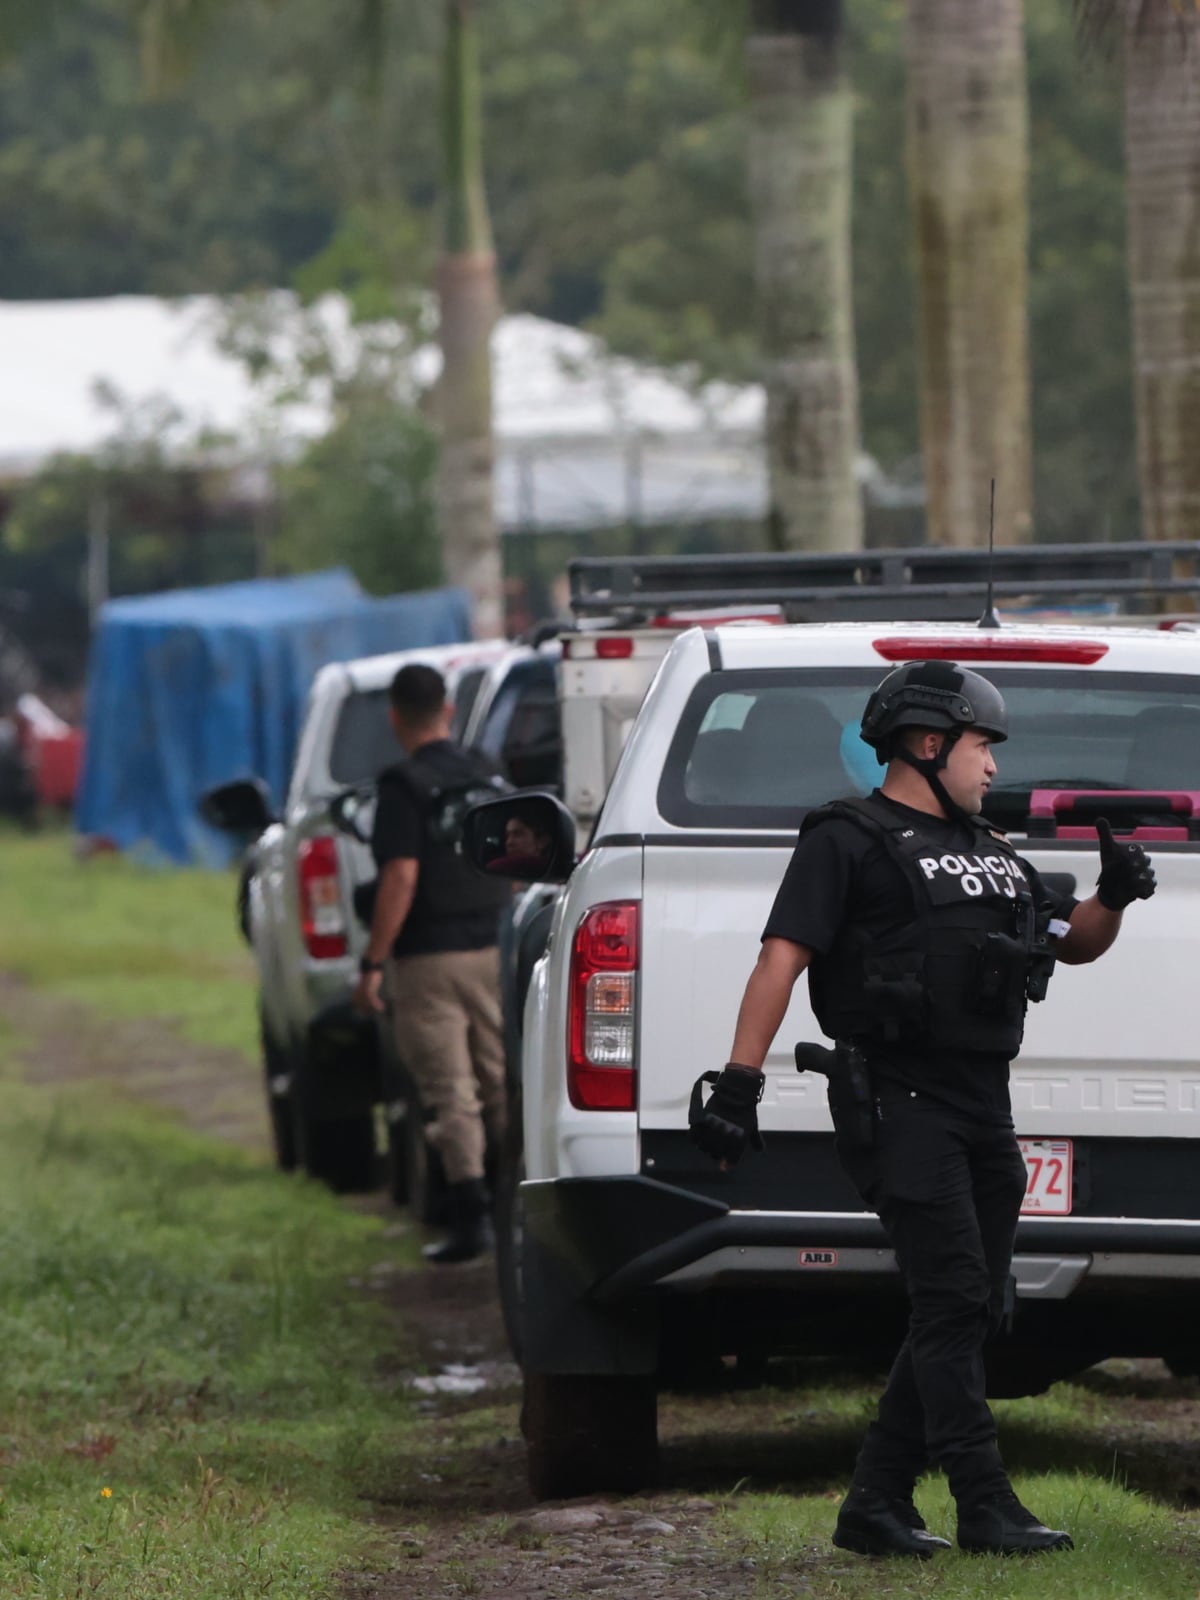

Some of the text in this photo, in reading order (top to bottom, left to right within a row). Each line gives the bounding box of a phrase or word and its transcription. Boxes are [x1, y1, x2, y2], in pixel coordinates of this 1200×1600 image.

[919, 854, 1027, 882] POLICIA
[1026, 1157, 1064, 1195] 72
[804, 1253, 833, 1263] ARB
